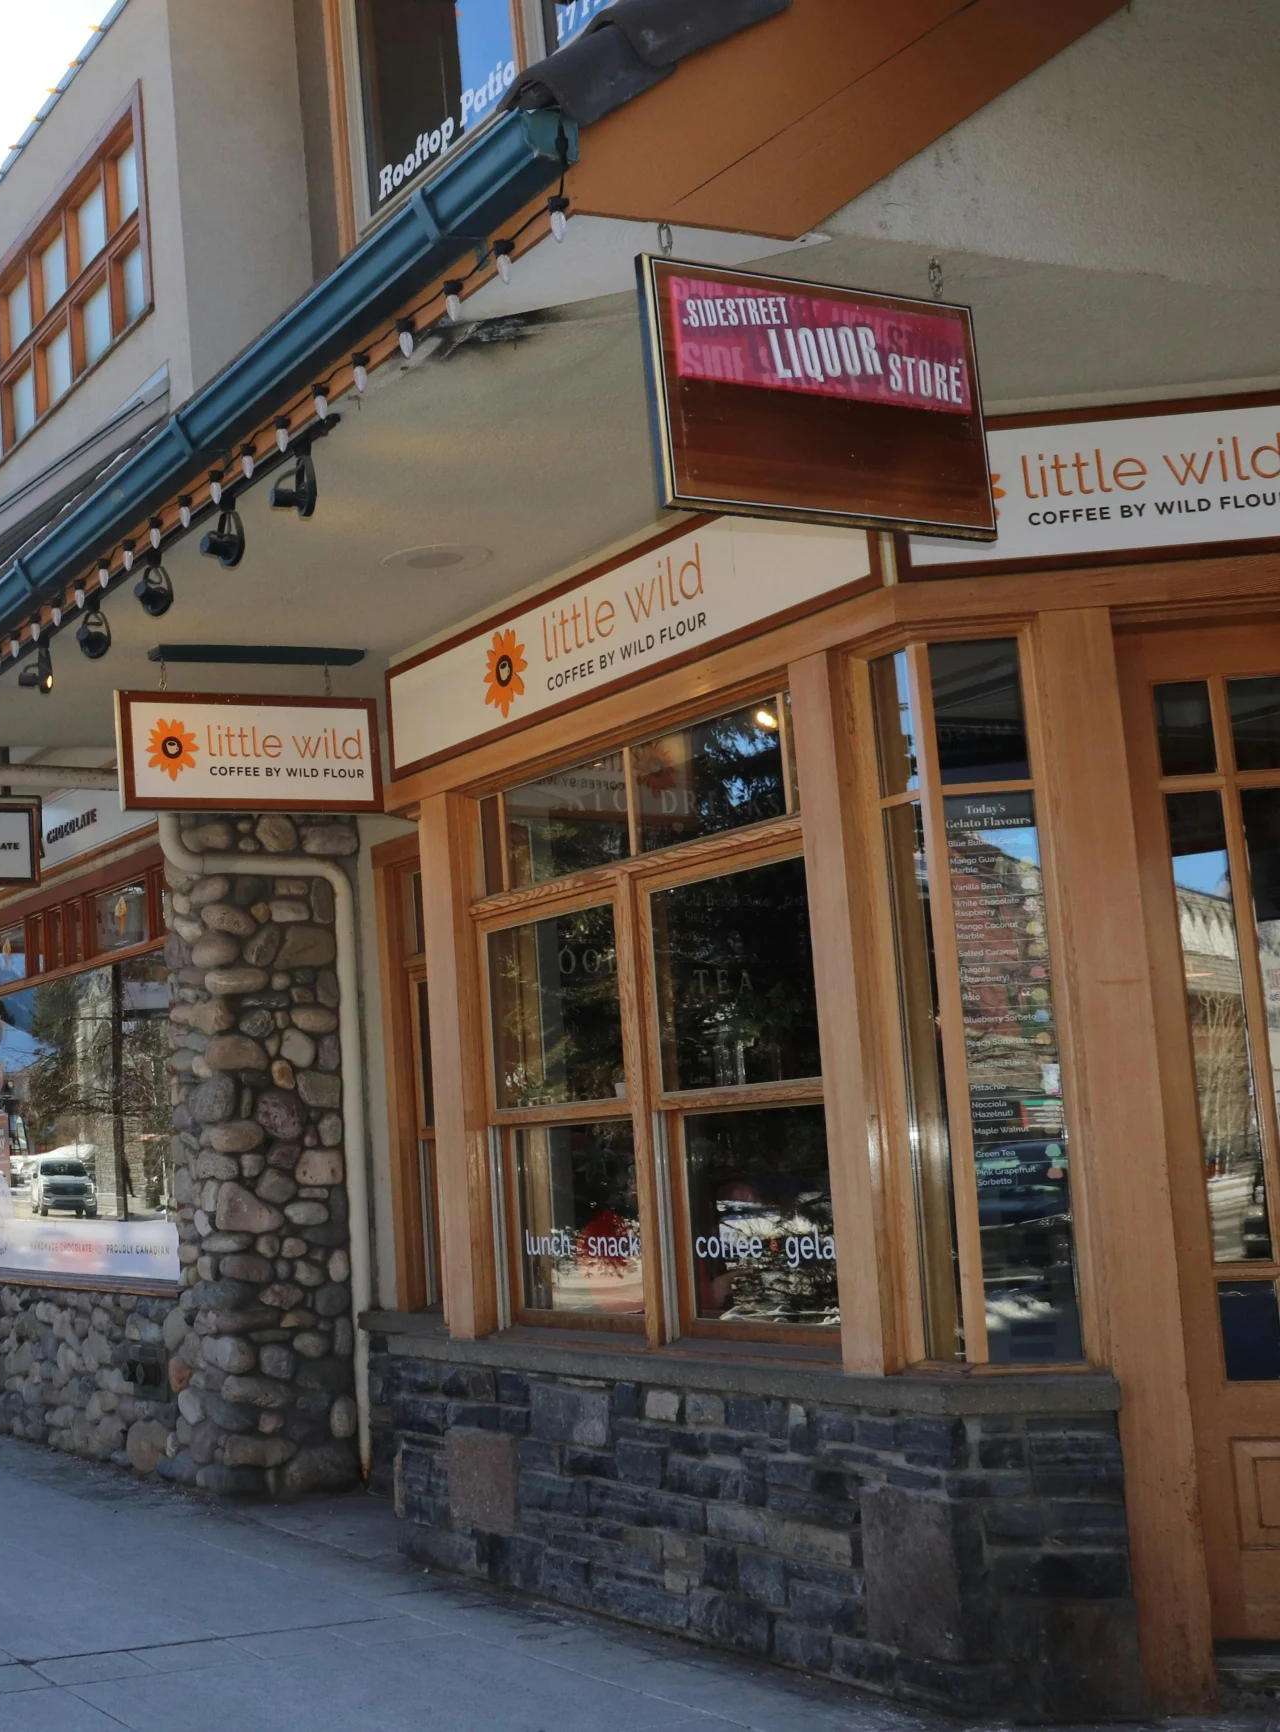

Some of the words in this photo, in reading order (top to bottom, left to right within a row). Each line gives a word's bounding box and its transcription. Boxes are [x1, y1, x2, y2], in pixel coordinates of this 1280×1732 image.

[378, 116, 455, 202] Rooftop
[460, 60, 516, 129] Patio
[685, 297, 790, 328] SIDESTREET
[767, 326, 884, 383] LIQUOR
[887, 352, 963, 405] STORE
[1021, 448, 1148, 500] little
[1162, 432, 1280, 486] wild
[1028, 506, 1111, 527] COFFEE
[1120, 503, 1147, 518] BY
[1154, 497, 1212, 516] WILD
[1219, 491, 1280, 511] FLOU
[542, 596, 616, 663] little
[625, 542, 705, 624] wild
[547, 659, 595, 692] COFFEE
[599, 649, 616, 671] BY
[619, 634, 656, 661] WILD
[660, 611, 707, 643] FLOUR
[207, 725, 283, 758] little
[292, 728, 364, 760] wild
[209, 766, 260, 777] COFFEE
[265, 767, 282, 777] BY
[287, 767, 319, 778] WILD
[323, 768, 365, 779] FLOUR
[965, 803, 1006, 816] Today's
[47, 808, 97, 844] CHOCOLATE
[946, 817, 981, 829] Gelato
[983, 816, 1031, 827] Flavours
[948, 840, 967, 848] Blue
[950, 857, 977, 866] Mango
[953, 883, 979, 891] Vanilla
[981, 882, 1002, 890] Bean
[955, 908, 995, 917] Raspberry
[956, 922, 983, 931] Mango
[693, 969, 754, 994] TEA
[963, 1015, 1004, 1024] Blueberry
[970, 1083, 1007, 1091] Pistachio
[972, 1100, 1007, 1108] Nocciola
[972, 1109, 1014, 1119] (Hazelnut)
[974, 1127, 999, 1136] Maple
[999, 1126, 1030, 1134] Walnut
[976, 1168, 994, 1176] Pink
[995, 1166, 1036, 1177] Grapefruit
[60, 1244, 93, 1253] CHOCOLATE
[106, 1244, 134, 1254] PROUDLY
[135, 1245, 170, 1255] CANADIAN
[525, 1230, 571, 1256] lunch
[695, 1230, 763, 1260] coffee
